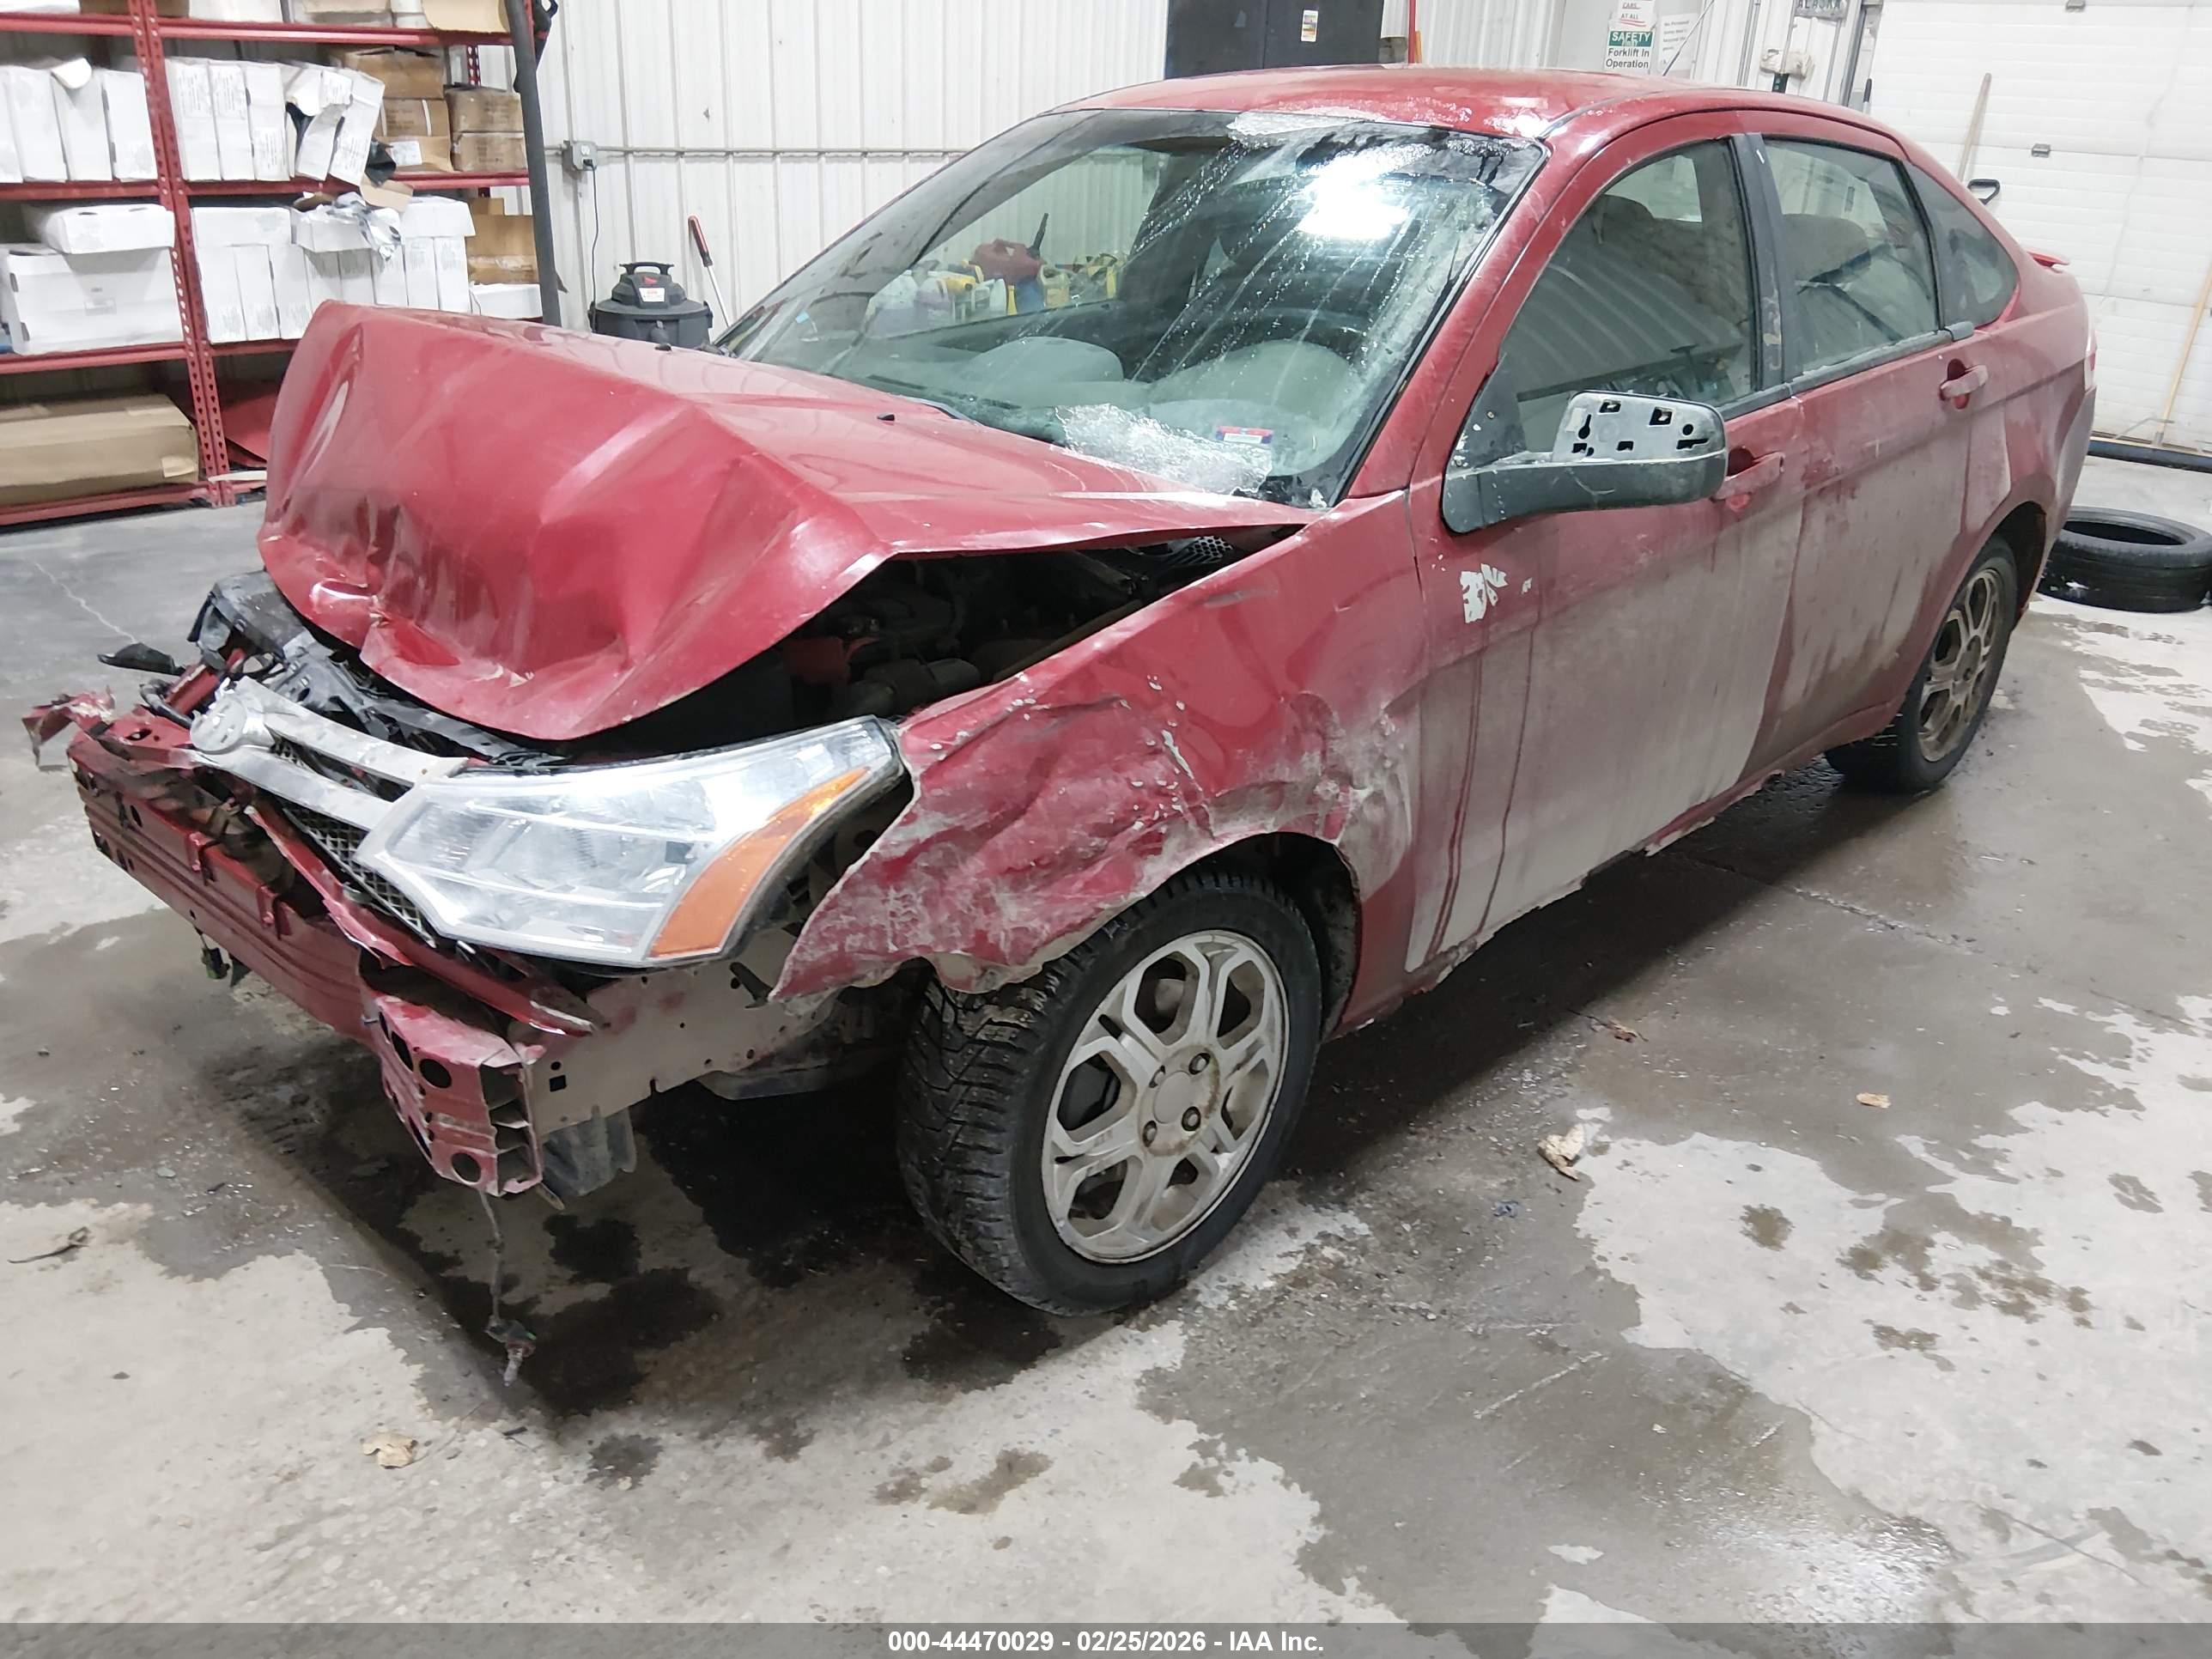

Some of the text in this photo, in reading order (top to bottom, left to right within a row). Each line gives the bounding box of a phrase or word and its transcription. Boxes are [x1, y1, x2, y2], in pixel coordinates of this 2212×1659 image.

[1612, 32, 1651, 42] SAFETY
[1607, 47, 1650, 58] Forklift In
[1606, 58, 1650, 69] Operation
